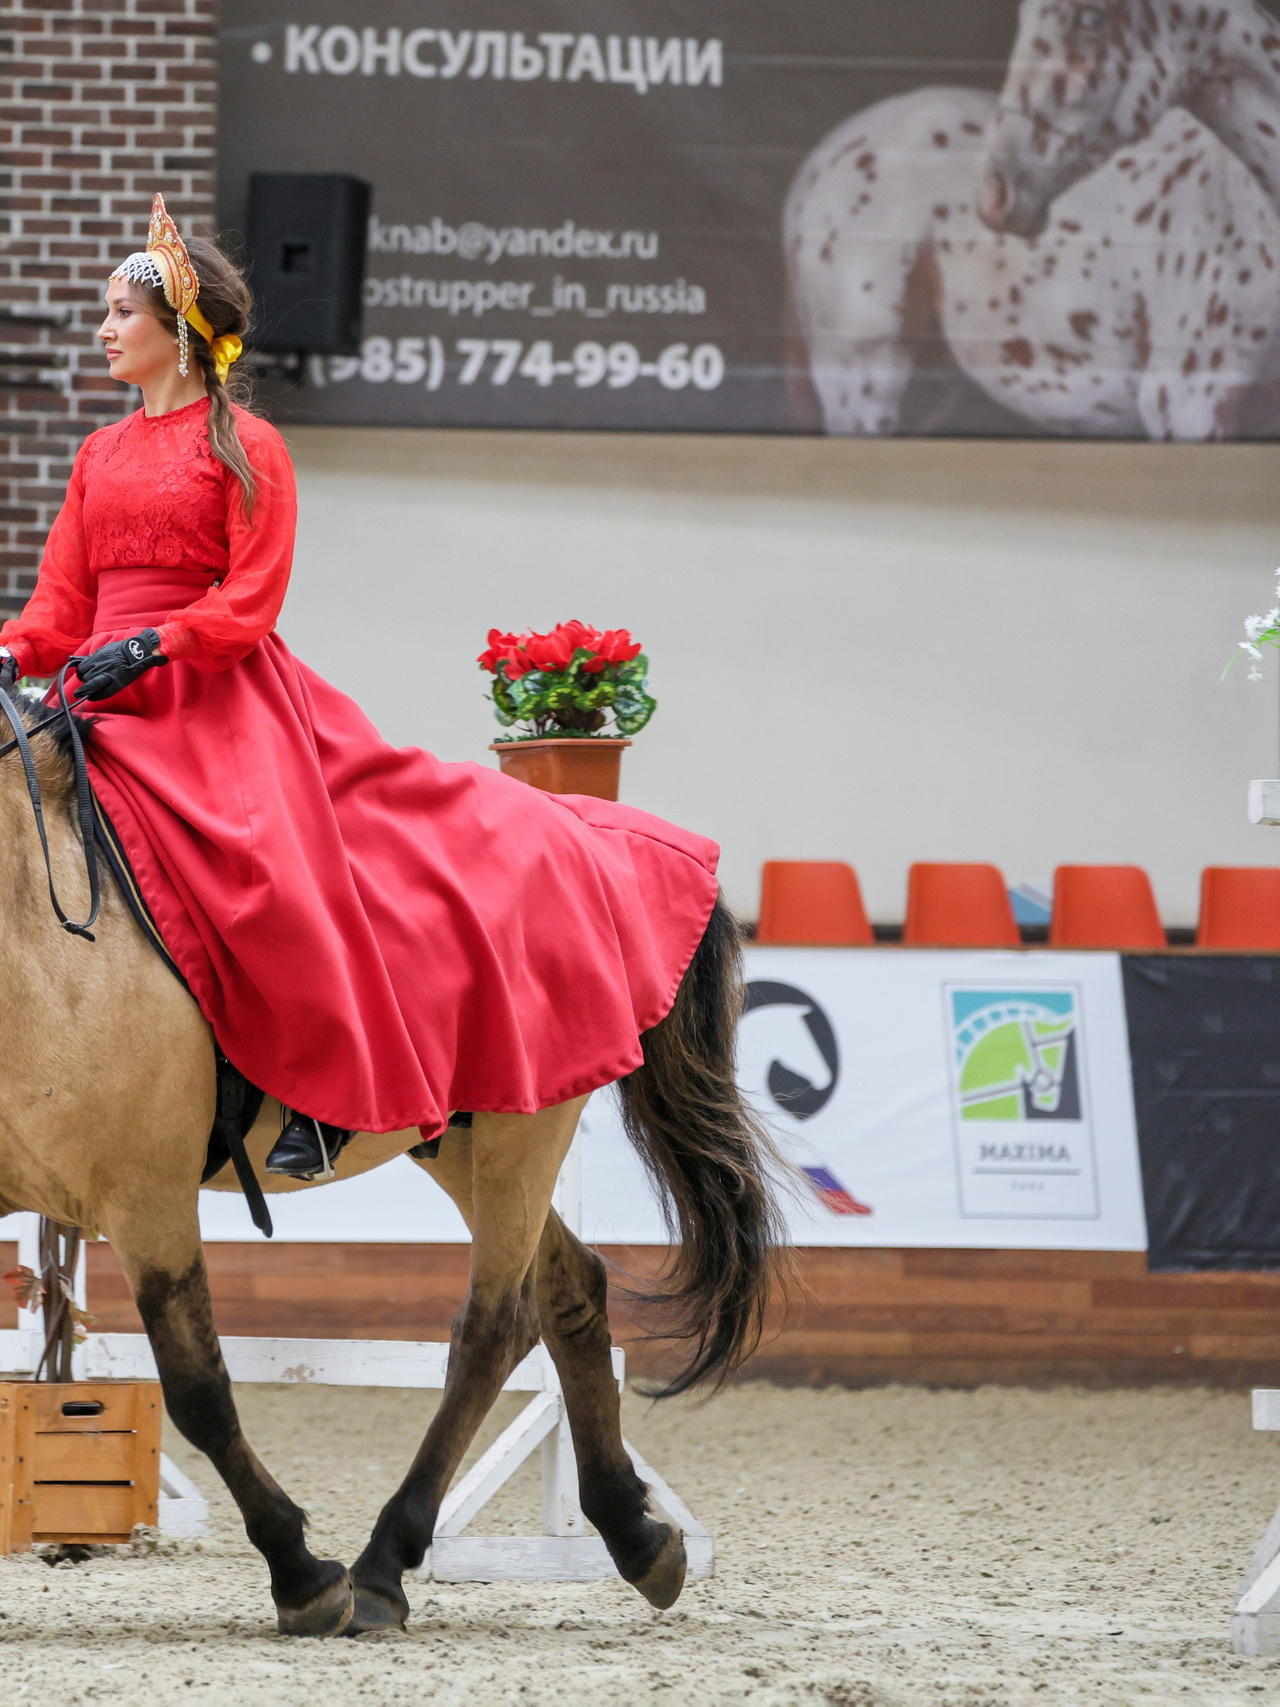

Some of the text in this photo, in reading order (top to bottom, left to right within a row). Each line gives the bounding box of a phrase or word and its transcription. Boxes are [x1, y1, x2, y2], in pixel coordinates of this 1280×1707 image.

[284, 24, 723, 95] КОНСУЛЬТАЦИИ
[367, 215, 659, 264] knab@yandex.ru
[361, 274, 707, 318] strupper_in_russia
[456, 339, 725, 391] 774-99-60
[978, 1142, 1072, 1163] MAXIMA
